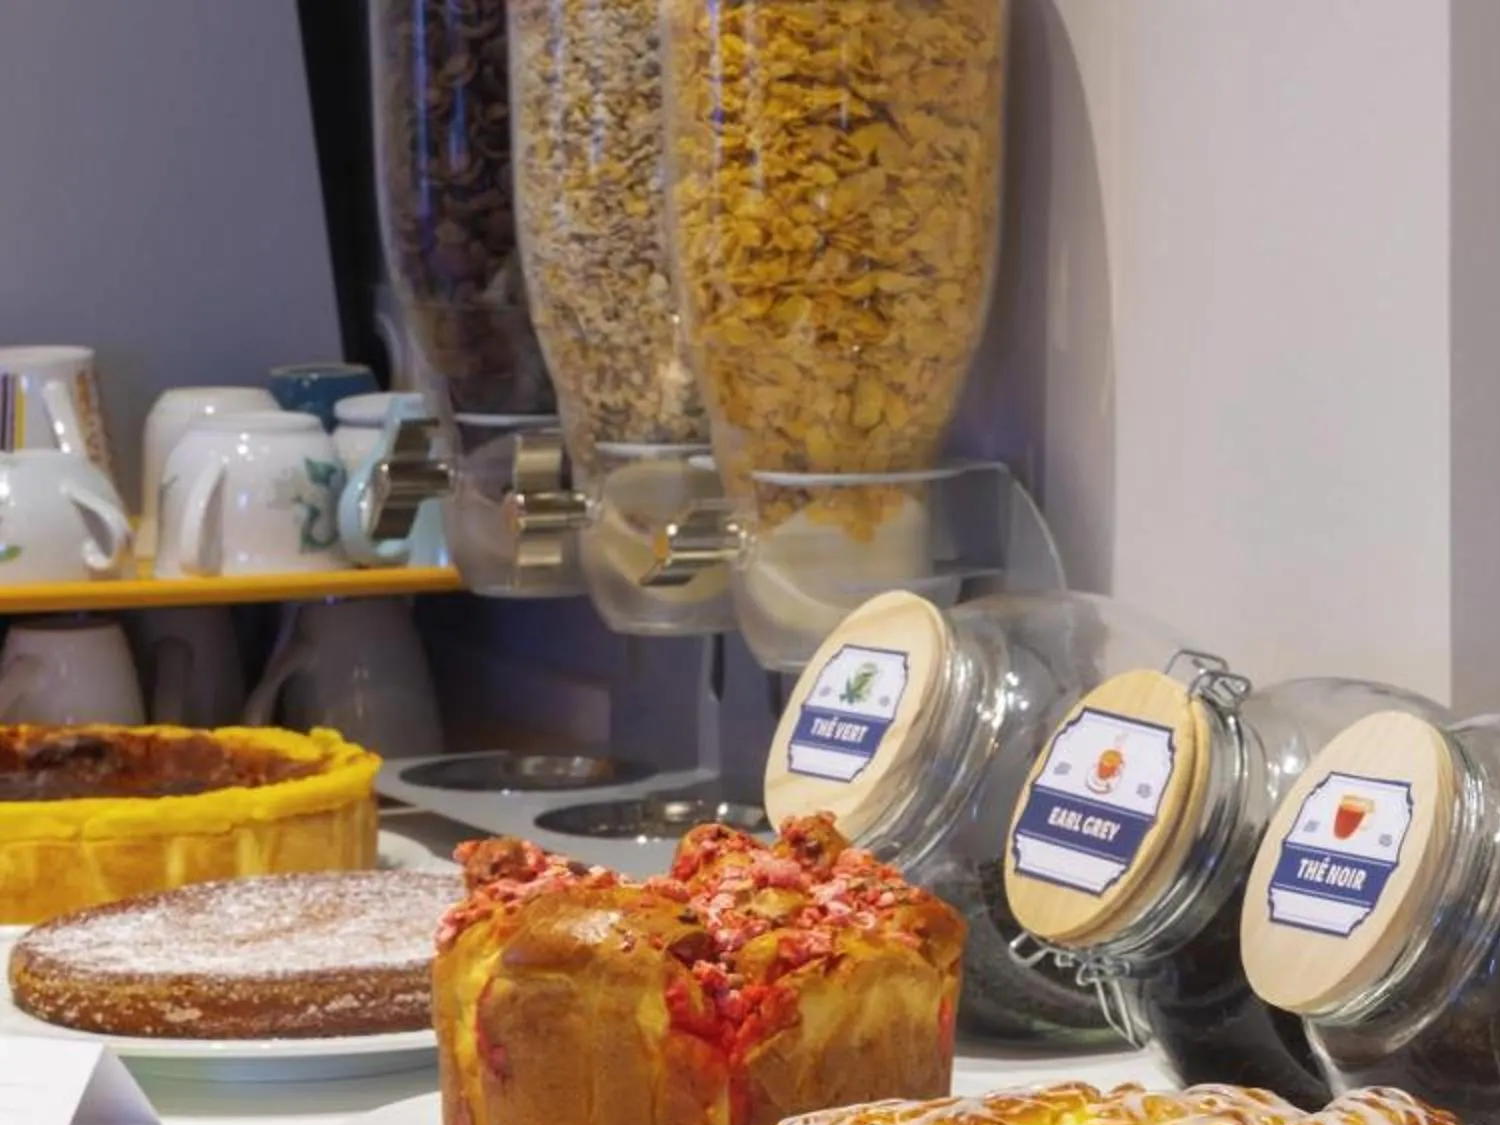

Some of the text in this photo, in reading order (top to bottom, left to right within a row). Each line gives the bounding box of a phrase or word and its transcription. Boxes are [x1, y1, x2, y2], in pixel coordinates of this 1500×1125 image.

[811, 716, 869, 743] THÉ VERT
[1047, 806, 1121, 842] EARL GREY
[1297, 856, 1367, 891] THÉ NOIR
